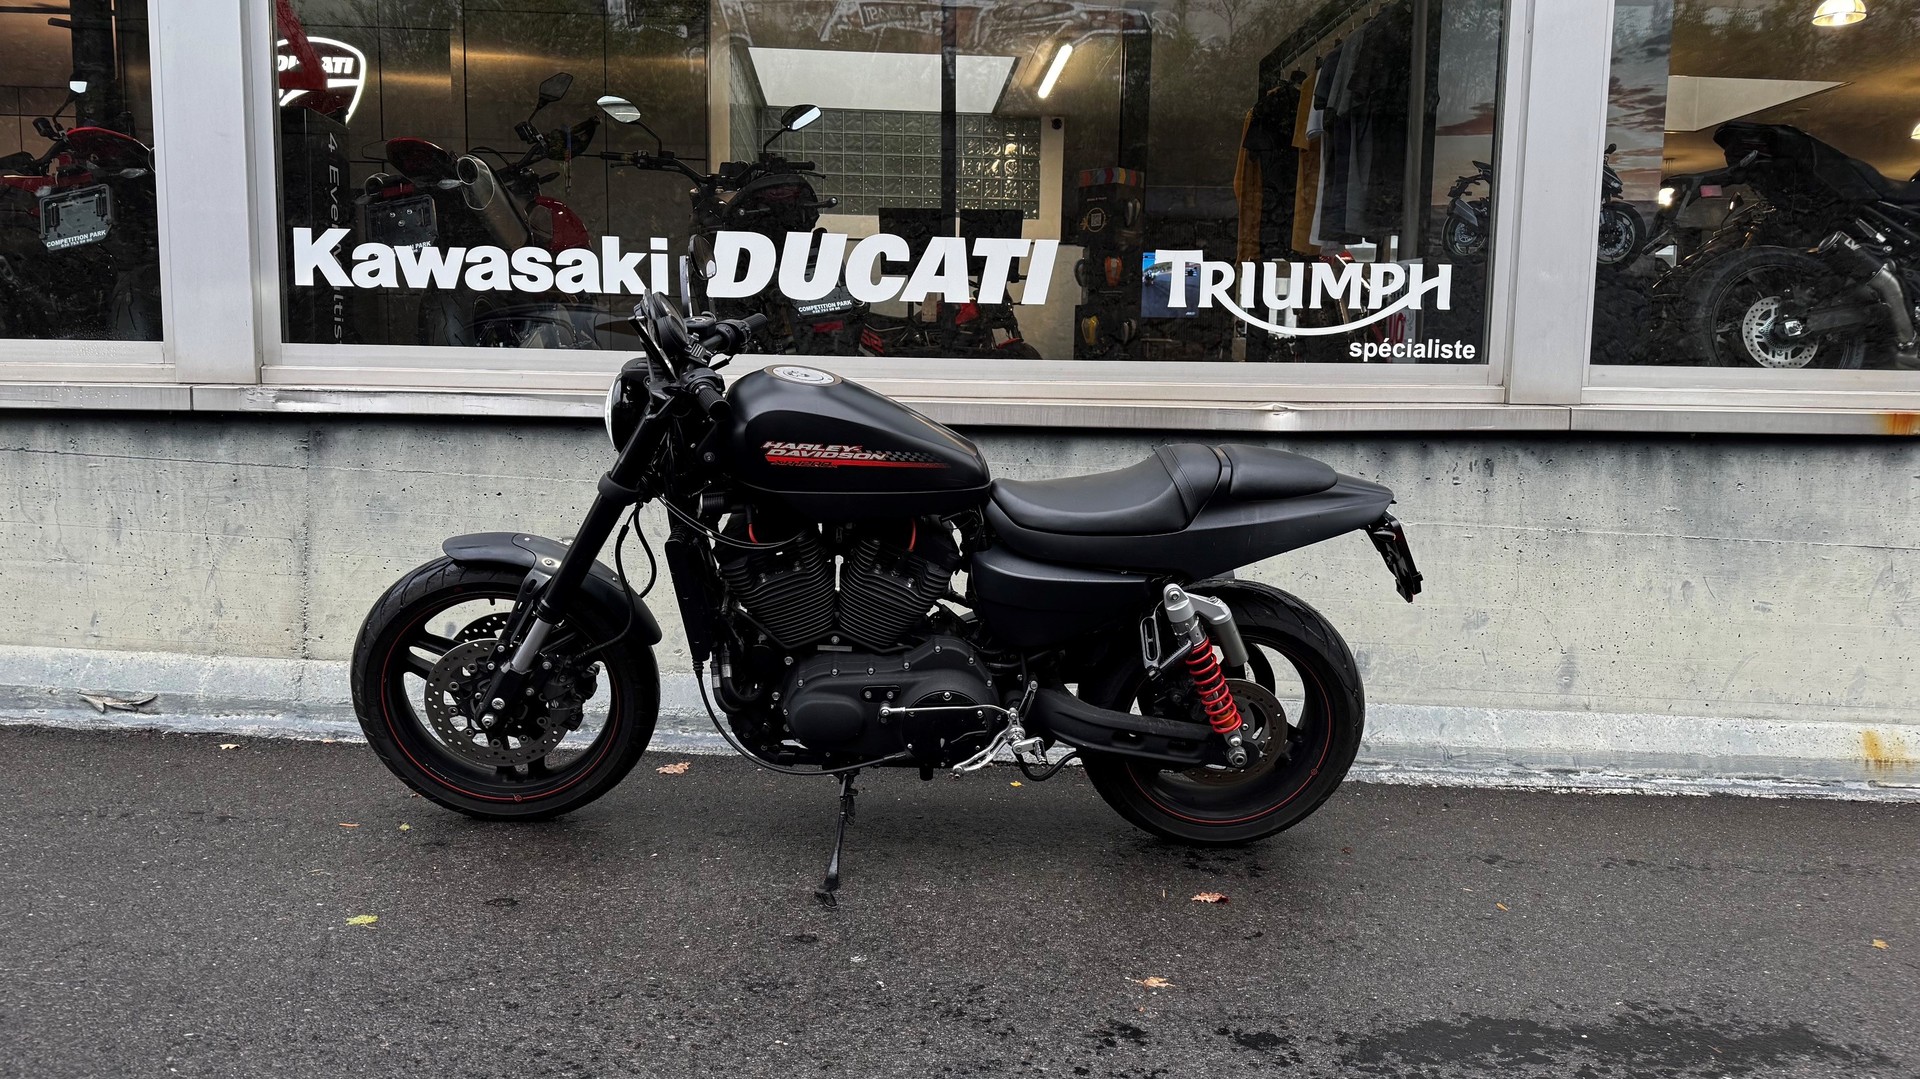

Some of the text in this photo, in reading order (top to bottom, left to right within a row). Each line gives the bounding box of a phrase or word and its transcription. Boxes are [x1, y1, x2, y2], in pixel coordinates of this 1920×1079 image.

[277, 55, 354, 74] DATI
[46, 230, 106, 248] COMPETITION PARK
[294, 227, 669, 295] Kawasaki
[707, 231, 1061, 305] DUCATI
[1154, 249, 1453, 336] TRIUMPH
[798, 303, 836, 313] COMPETITION
[1349, 338, 1476, 362] spécialiste
[767, 449, 887, 460] DAVIDSON
